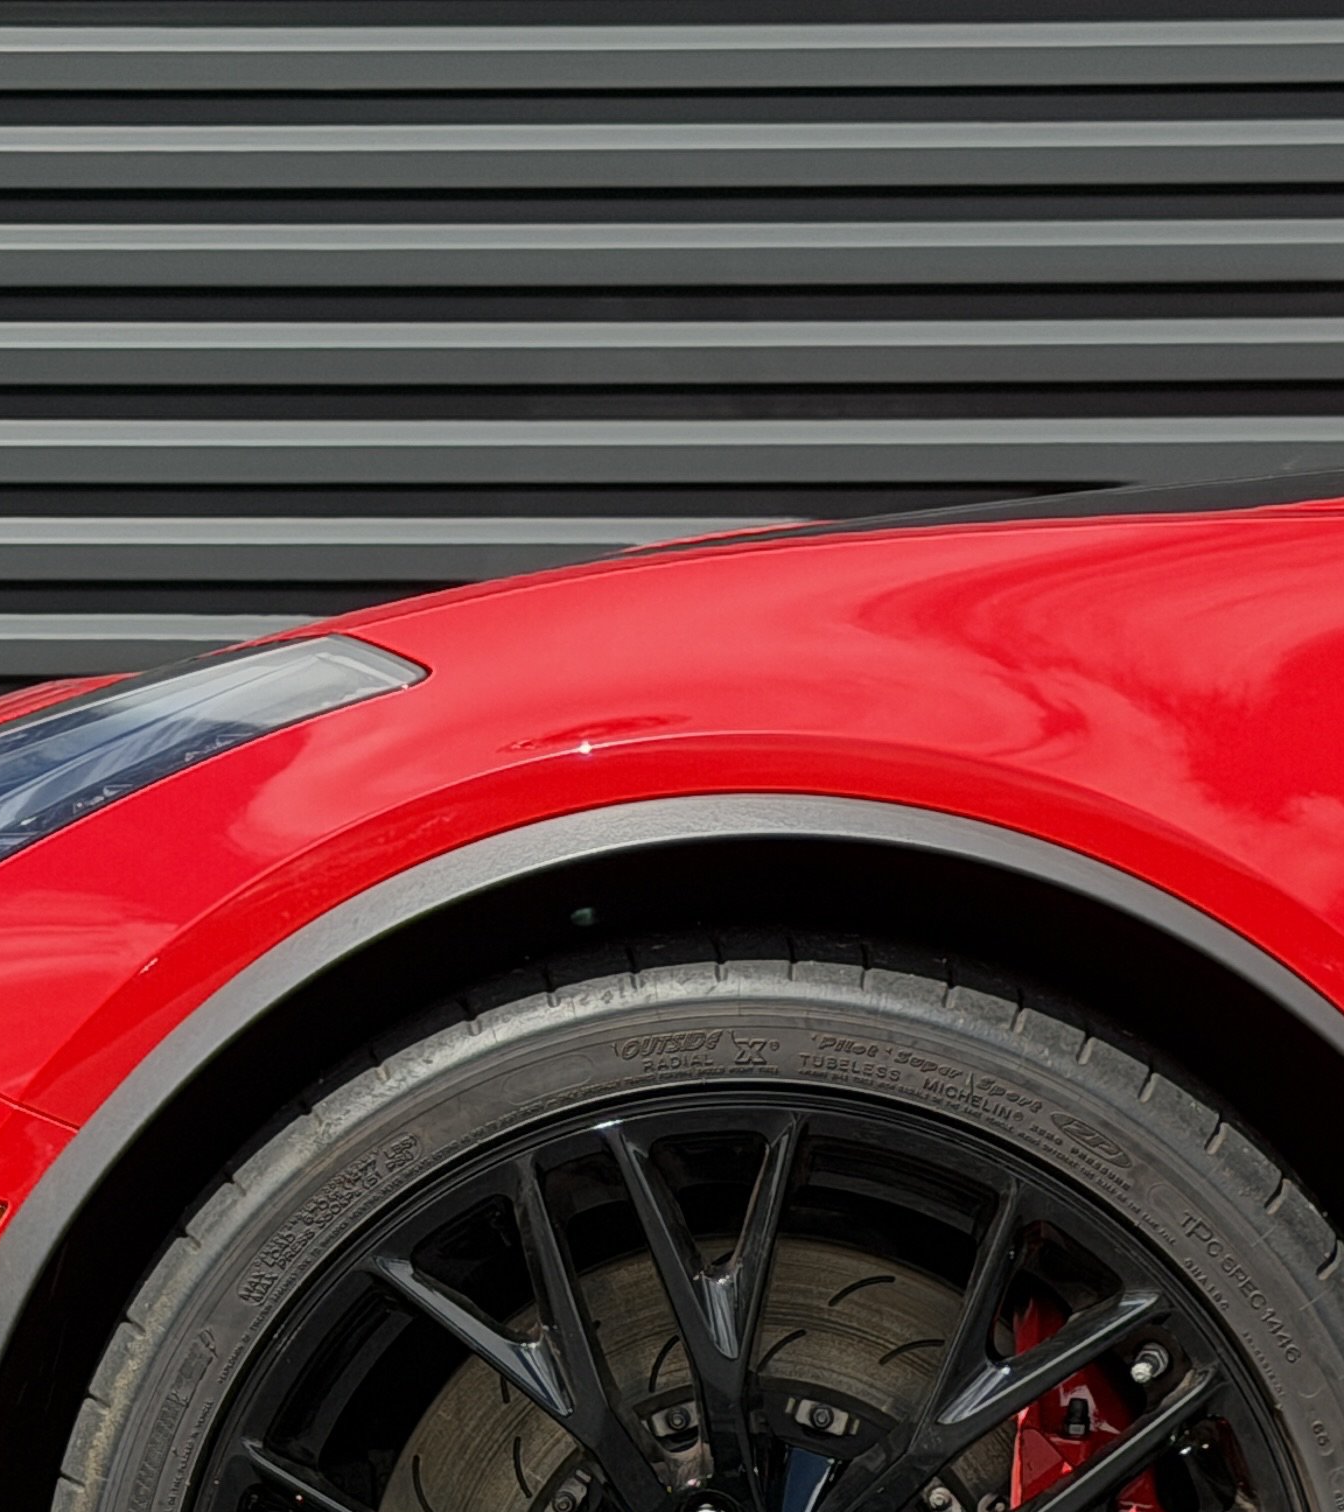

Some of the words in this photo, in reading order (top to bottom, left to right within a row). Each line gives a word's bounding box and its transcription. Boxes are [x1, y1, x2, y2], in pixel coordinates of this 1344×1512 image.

[619, 1028, 723, 1062] OUTSIDE
[641, 1051, 713, 1074] RADIAL
[798, 1053, 902, 1082] TUBELESS
[818, 1036, 879, 1057] Pilot
[893, 1048, 964, 1083] Super
[975, 1074, 1045, 1116] Sport
[1216, 1252, 1271, 1312] SPEC
[1259, 1308, 1306, 1366] 1446
